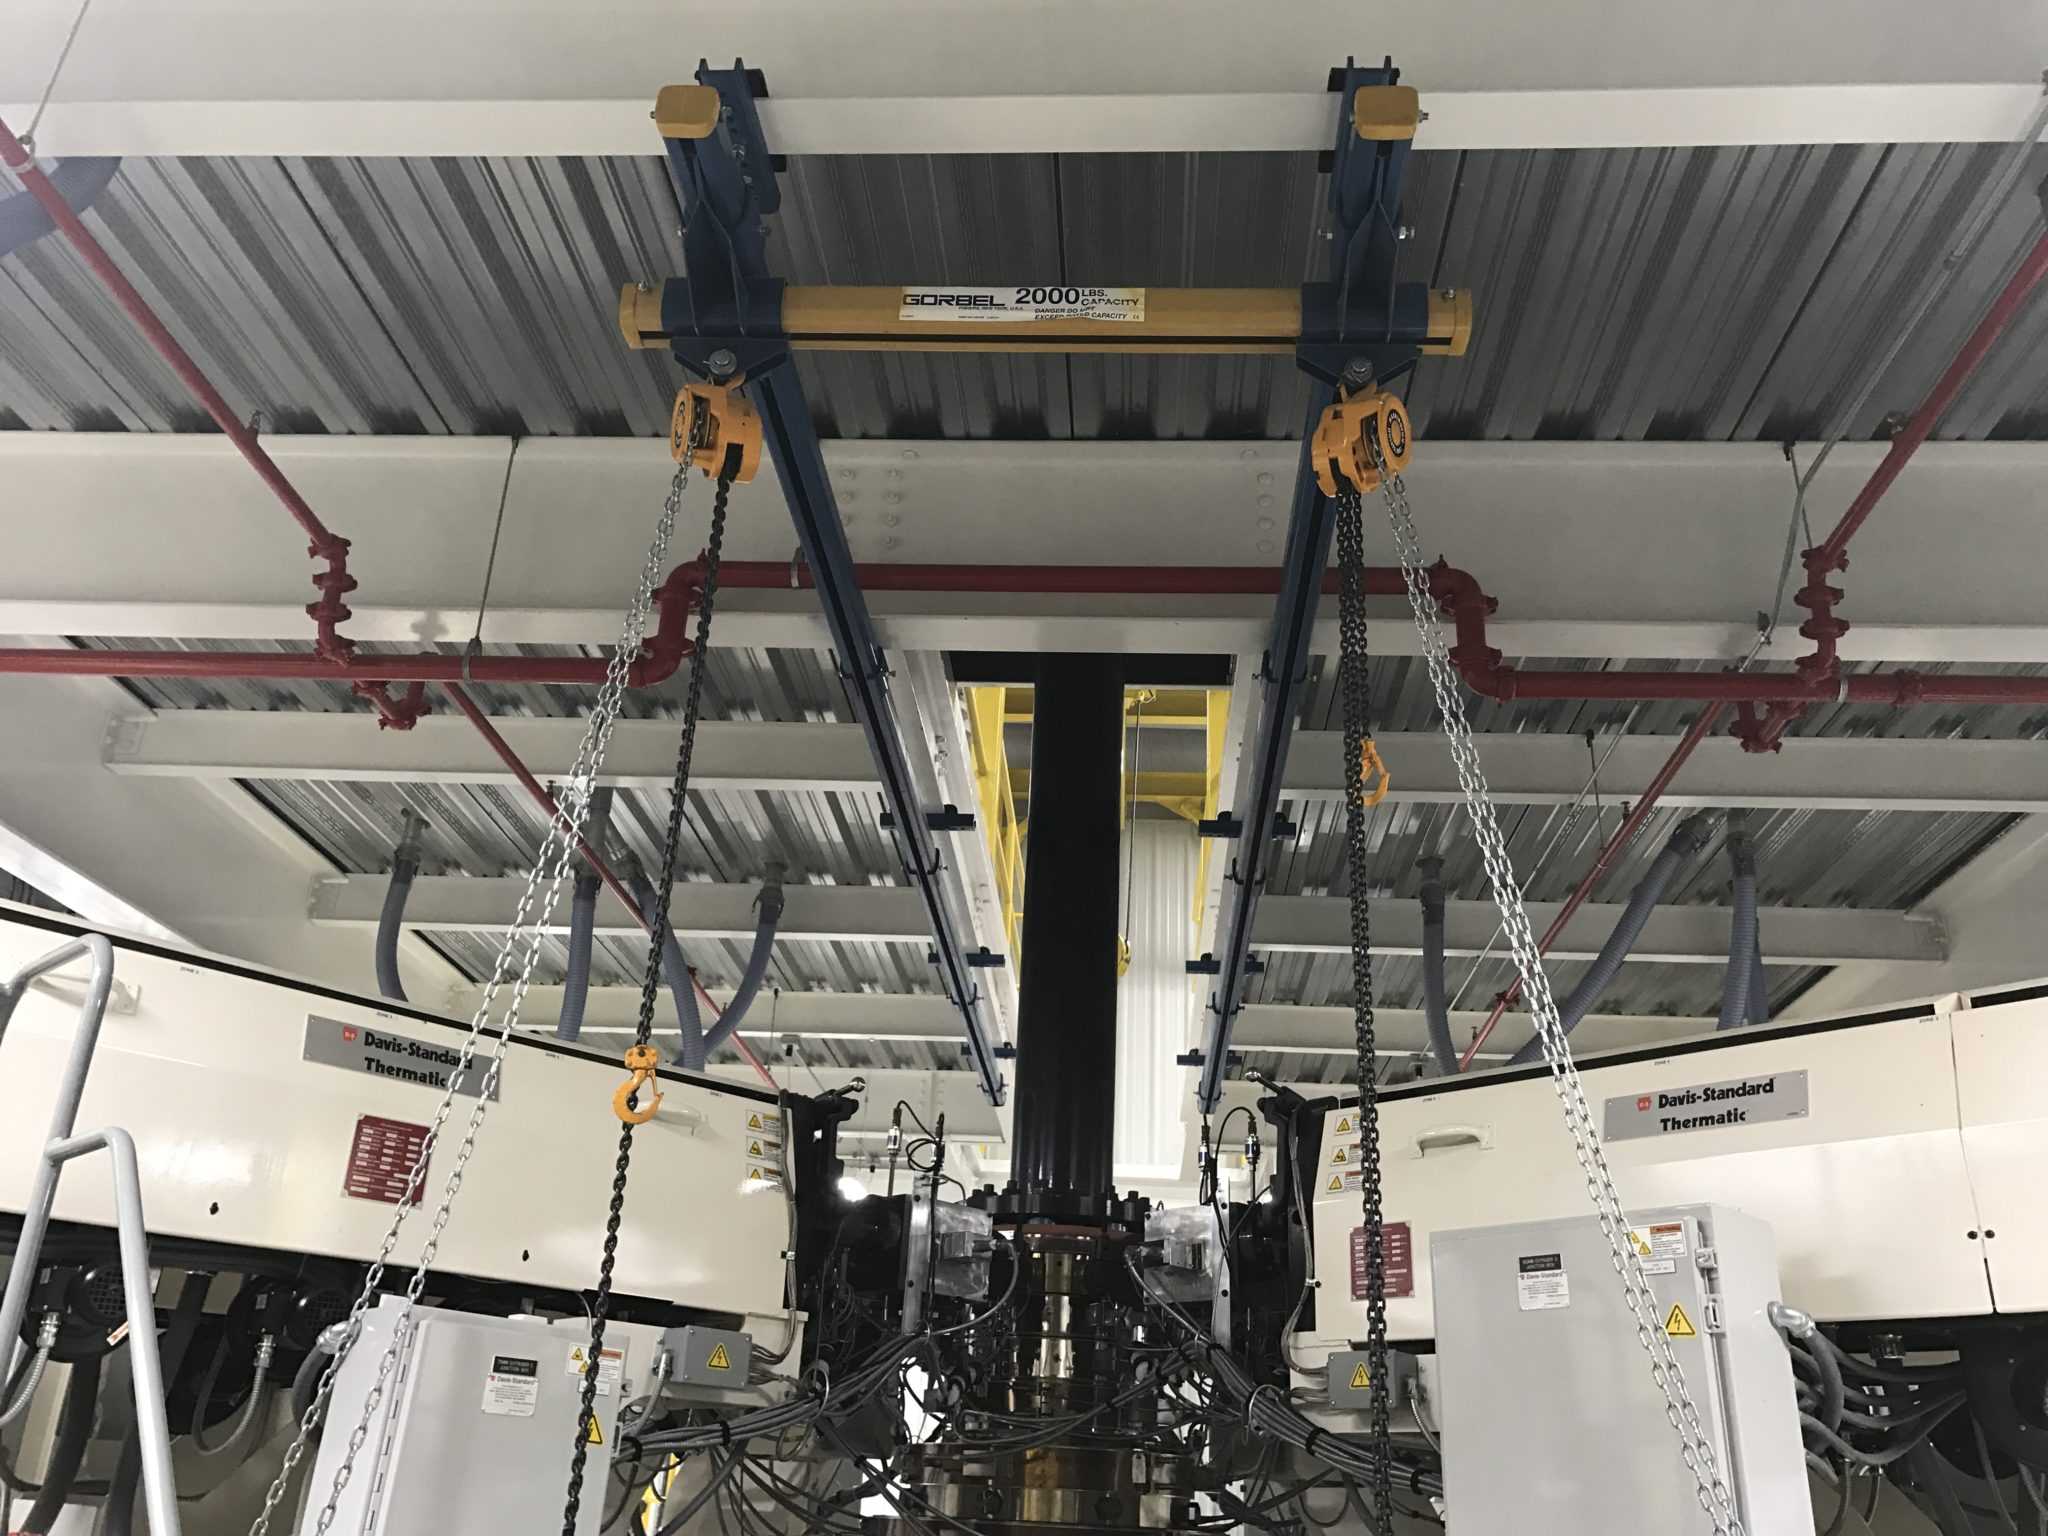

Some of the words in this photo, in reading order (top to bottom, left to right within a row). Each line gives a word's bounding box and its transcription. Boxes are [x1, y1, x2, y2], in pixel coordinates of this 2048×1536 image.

[902, 294, 1005, 307] GORBEL
[1015, 287, 1080, 305] 2000
[1081, 289, 1108, 298] LBS.
[1081, 298, 1139, 307] CAPACITY
[1091, 312, 1128, 320] CAPACITY
[363, 1031, 473, 1070] Davis-Standard
[364, 1056, 447, 1088] Thermatic
[1658, 1078, 1775, 1109] Davis-Standard
[1660, 1108, 1747, 1132] Thermatic
